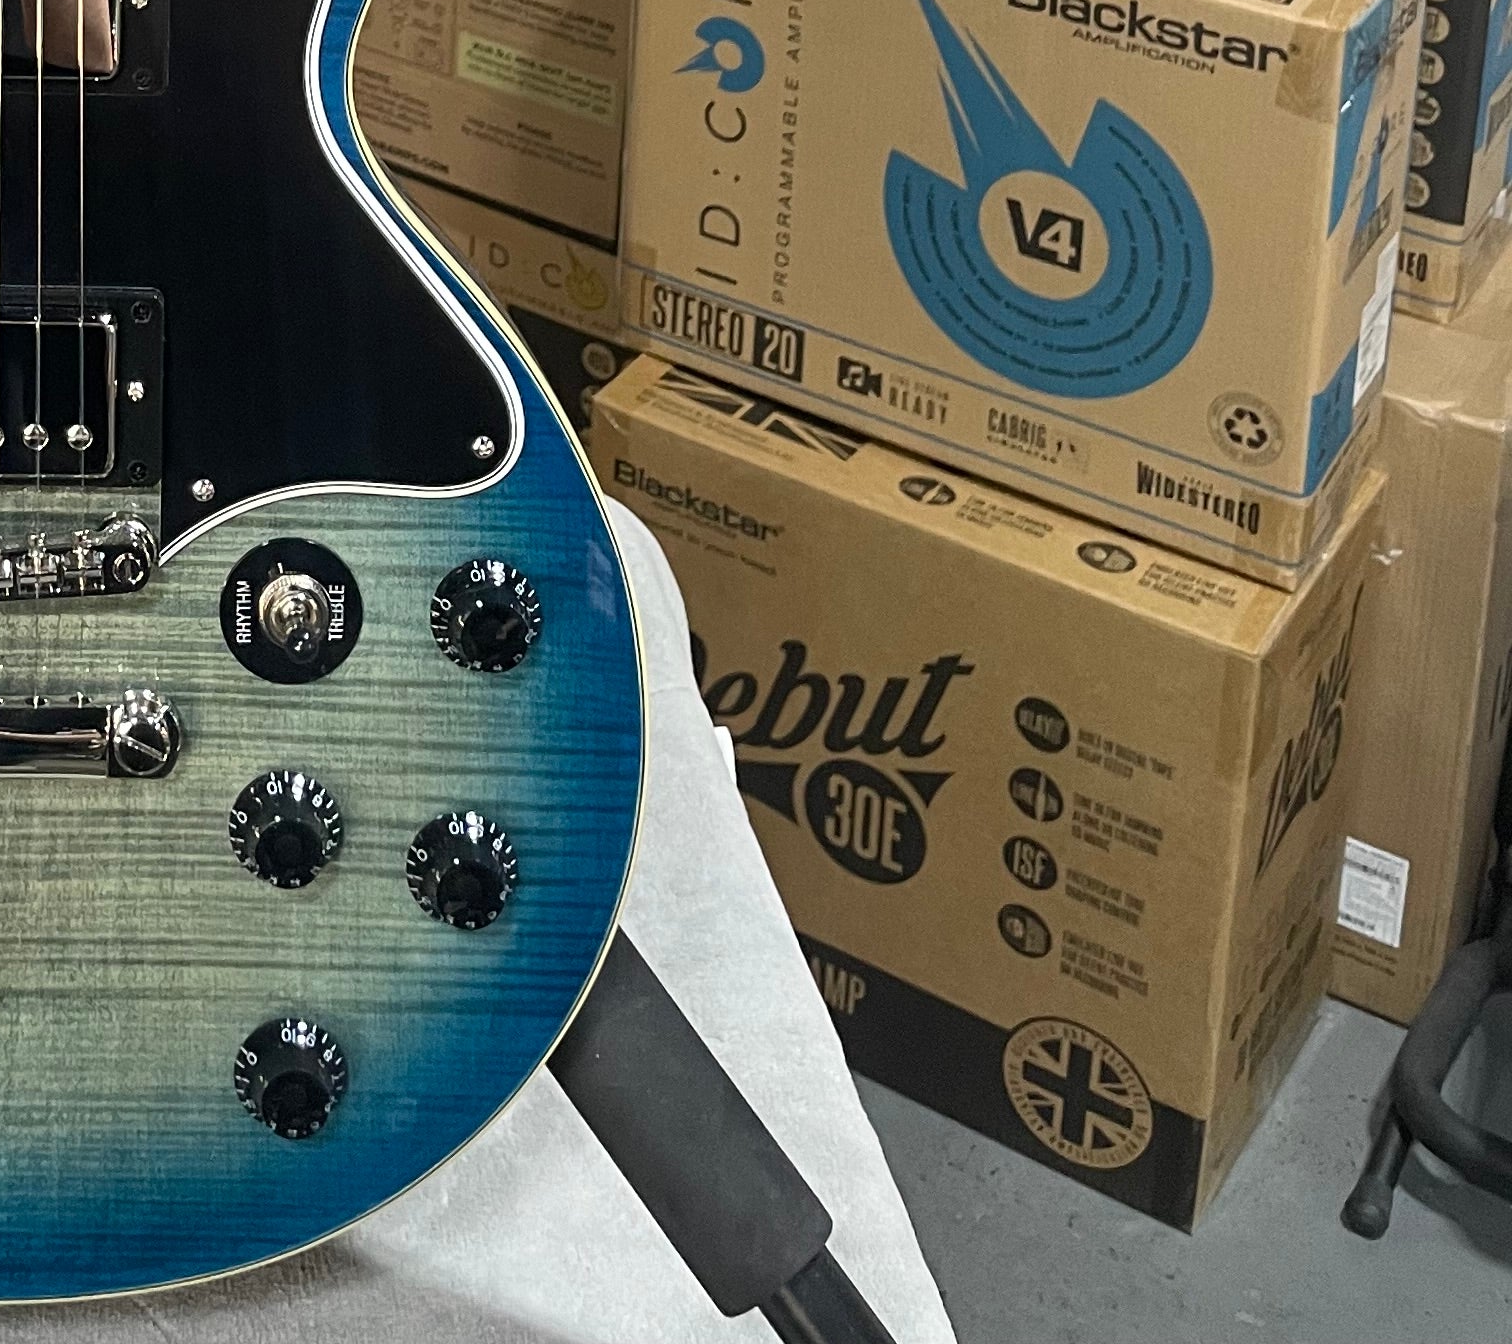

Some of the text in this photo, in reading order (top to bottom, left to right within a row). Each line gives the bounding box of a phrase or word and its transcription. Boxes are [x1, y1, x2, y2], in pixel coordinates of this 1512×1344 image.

[1072, 28, 1216, 75] AMPLIFICATION
[772, 76, 800, 307] PROGRAMMABLE
[1006, 197, 1085, 273] V4
[652, 284, 797, 376] STEREO 20
[614, 457, 779, 542] Blackstar
[1137, 461, 1261, 536] WIDESTEREO
[235, 580, 252, 644] RHYTHM
[327, 583, 346, 642] TREBLE
[690, 631, 976, 758] ebut
[824, 772, 907, 875] 30E
[1013, 839, 1049, 885] ISF
